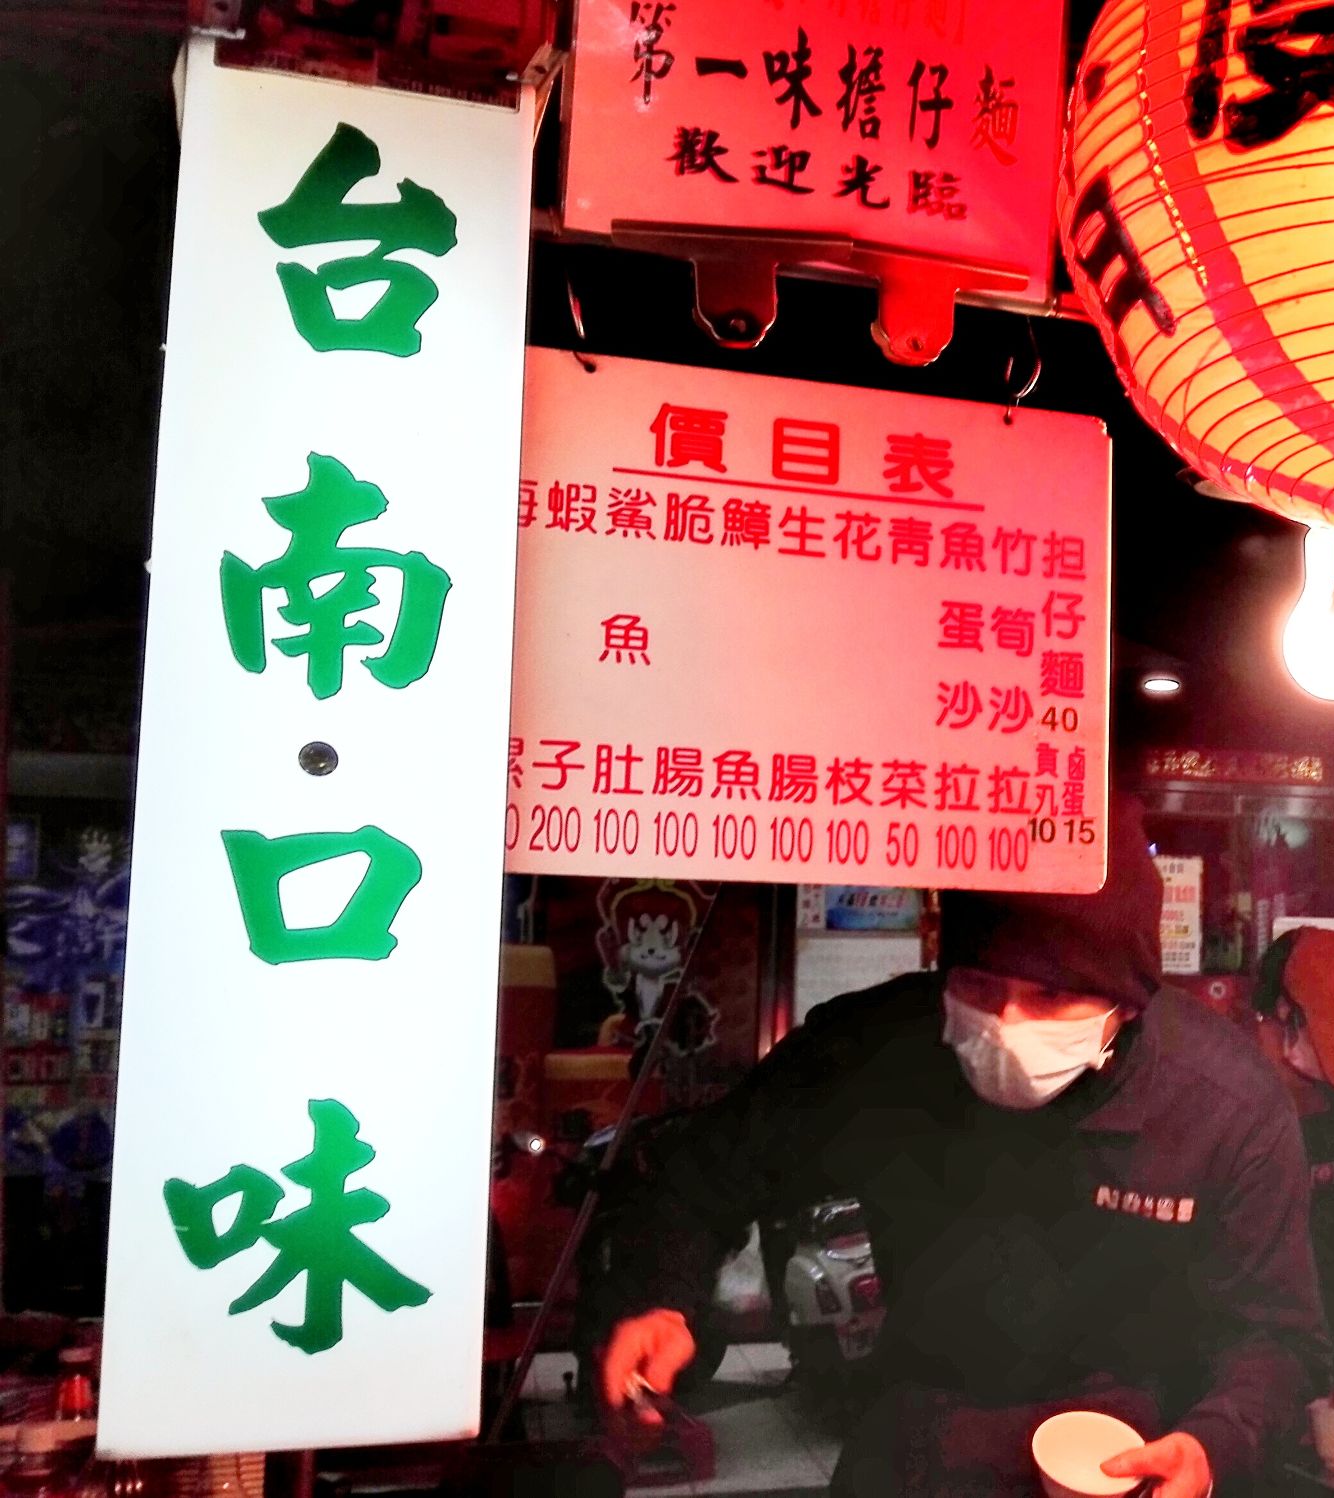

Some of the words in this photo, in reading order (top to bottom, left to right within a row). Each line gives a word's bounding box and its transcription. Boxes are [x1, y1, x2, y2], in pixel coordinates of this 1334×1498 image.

[665, 124, 970, 222] 歡迎光臨
[649, 402, 956, 499] 價目表
[1040, 530, 1087, 700] 担仔麵
[163, 121, 457, 1356] 台南口味
[1041, 706, 1079, 732] 40
[529, 804, 581, 851] 200
[593, 808, 640, 855] 100
[653, 811, 699, 858] 100
[712, 813, 757, 861] 100
[769, 816, 813, 864] 100
[826, 819, 870, 866] 100
[886, 822, 920, 868] 50
[936, 824, 977, 871] 100
[988, 827, 1029, 873] 100
[1028, 816, 1057, 844] 10
[1064, 818, 1096, 845] 15
